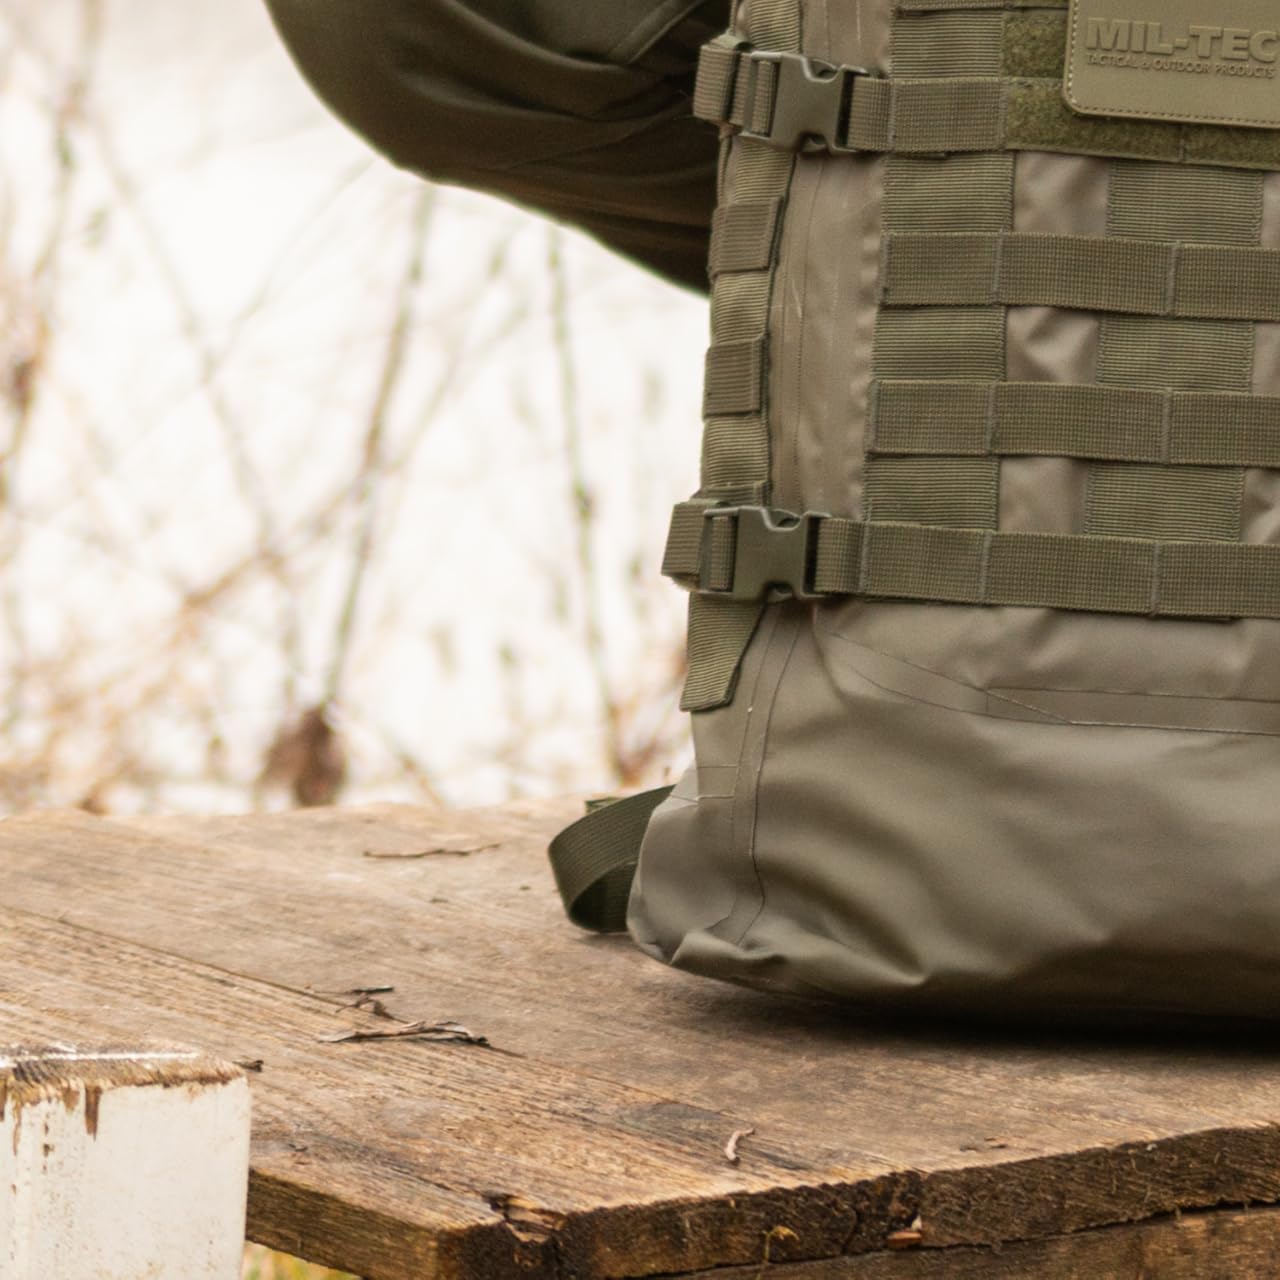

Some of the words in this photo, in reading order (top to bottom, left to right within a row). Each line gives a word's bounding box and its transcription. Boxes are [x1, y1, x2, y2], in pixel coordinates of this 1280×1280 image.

[1086, 53, 1138, 69] TACTICAL
[1152, 58, 1210, 73] OUTDOOR
[1215, 63, 1276, 79] PRODUCTS
